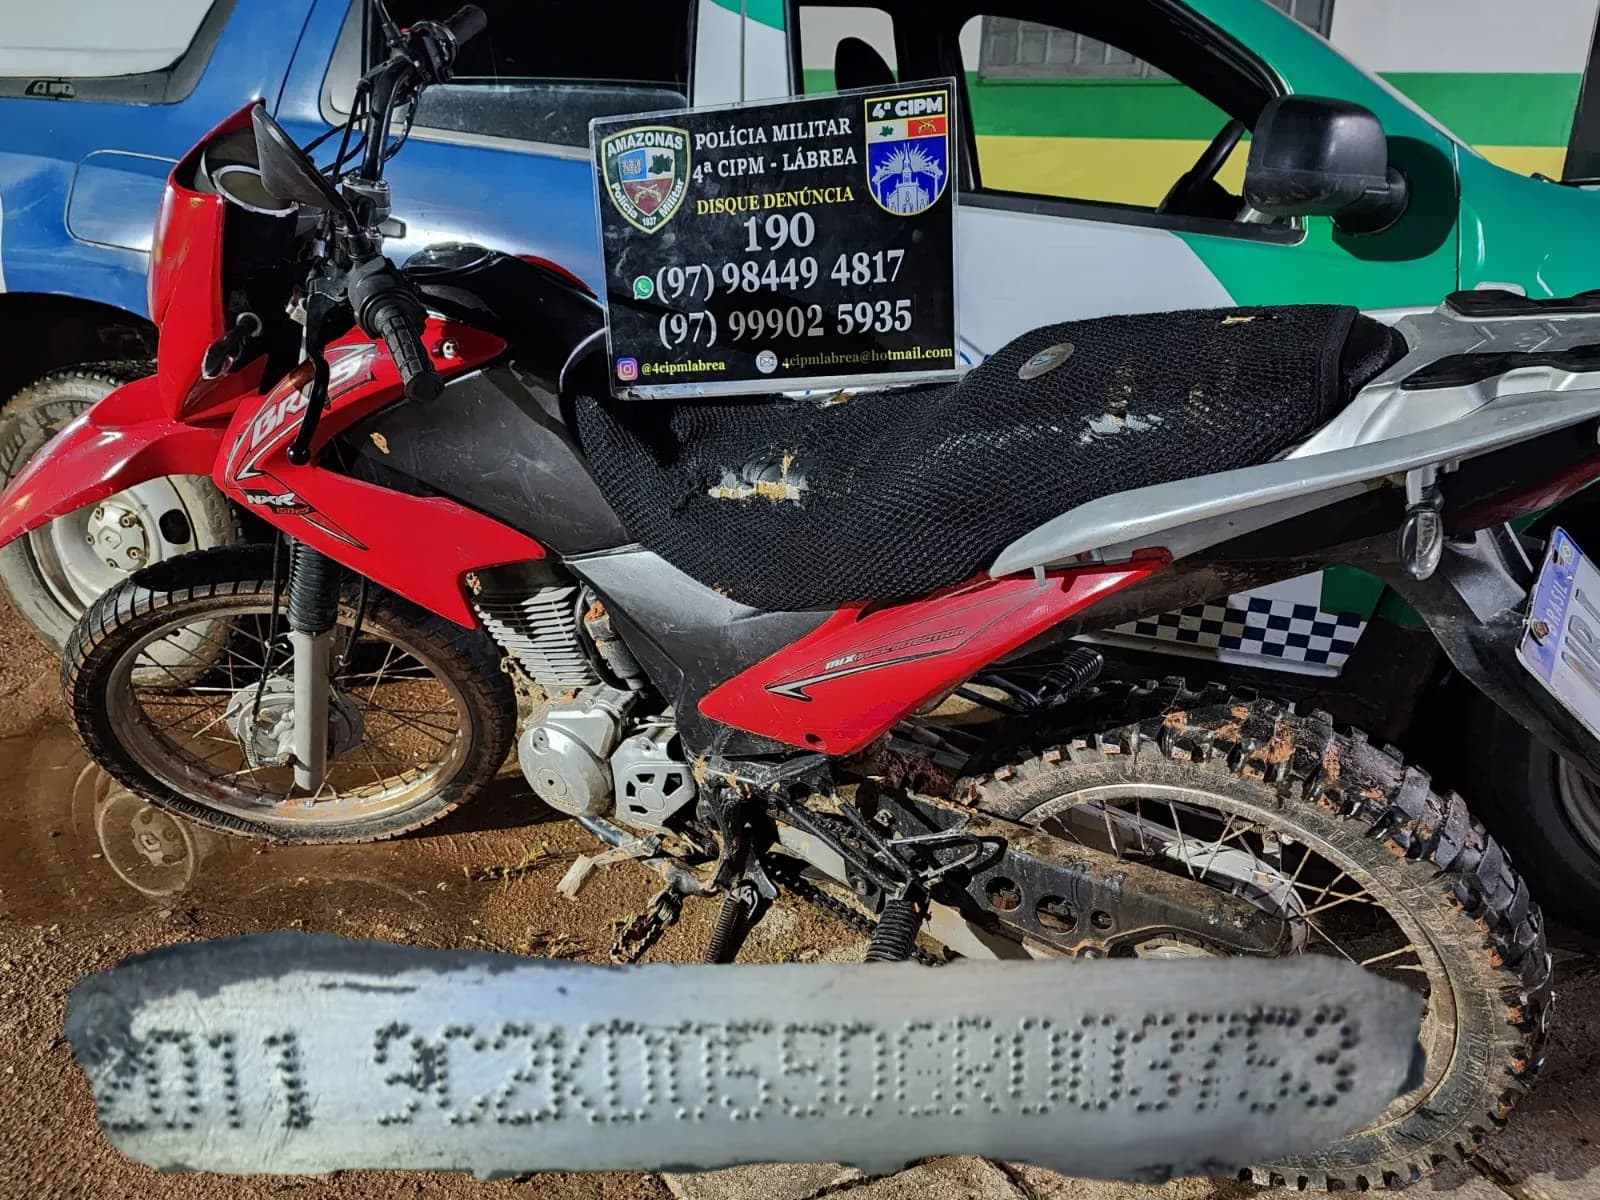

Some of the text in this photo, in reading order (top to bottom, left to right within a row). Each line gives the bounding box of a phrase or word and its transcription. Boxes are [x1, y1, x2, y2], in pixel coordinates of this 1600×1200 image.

[894, 97, 943, 117] CIPM
[607, 132, 684, 157] AMAZONAS
[695, 117, 852, 150] POLÍCIA MILITAR
[717, 156, 765, 178] CIPM
[782, 147, 858, 171] LÁBREA
[657, 177, 685, 218] Militar
[697, 186, 855, 216] DISQUE DENÚNCIA
[743, 212, 816, 252] 190
[656, 249, 905, 304] (97) 98449 4817
[658, 299, 912, 349] (97) 99902 5935
[641, 359, 726, 376] @4cipmlabrea
[782, 346, 953, 369] 4cipmlabrea@hotmail.com
